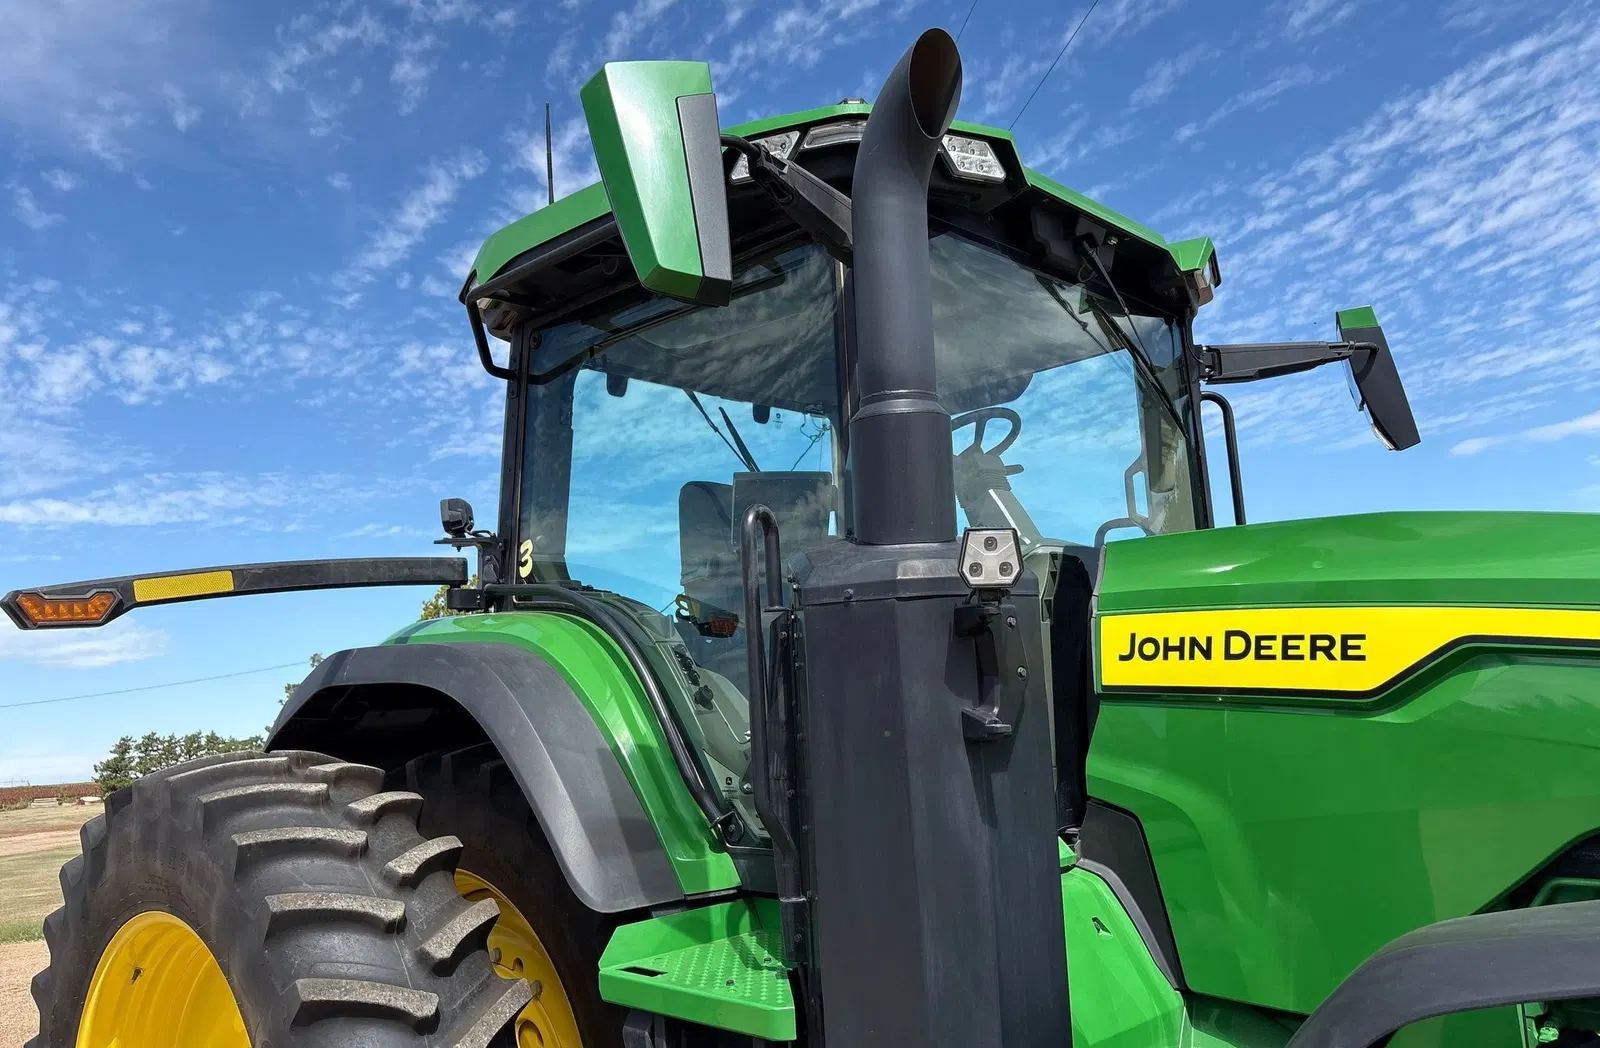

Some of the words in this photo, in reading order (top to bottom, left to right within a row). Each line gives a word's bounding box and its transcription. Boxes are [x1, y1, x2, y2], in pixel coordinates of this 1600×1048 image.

[519, 539, 533, 578] 3
[1118, 632, 1213, 662] JOHN
[1223, 629, 1367, 662] DEERE
